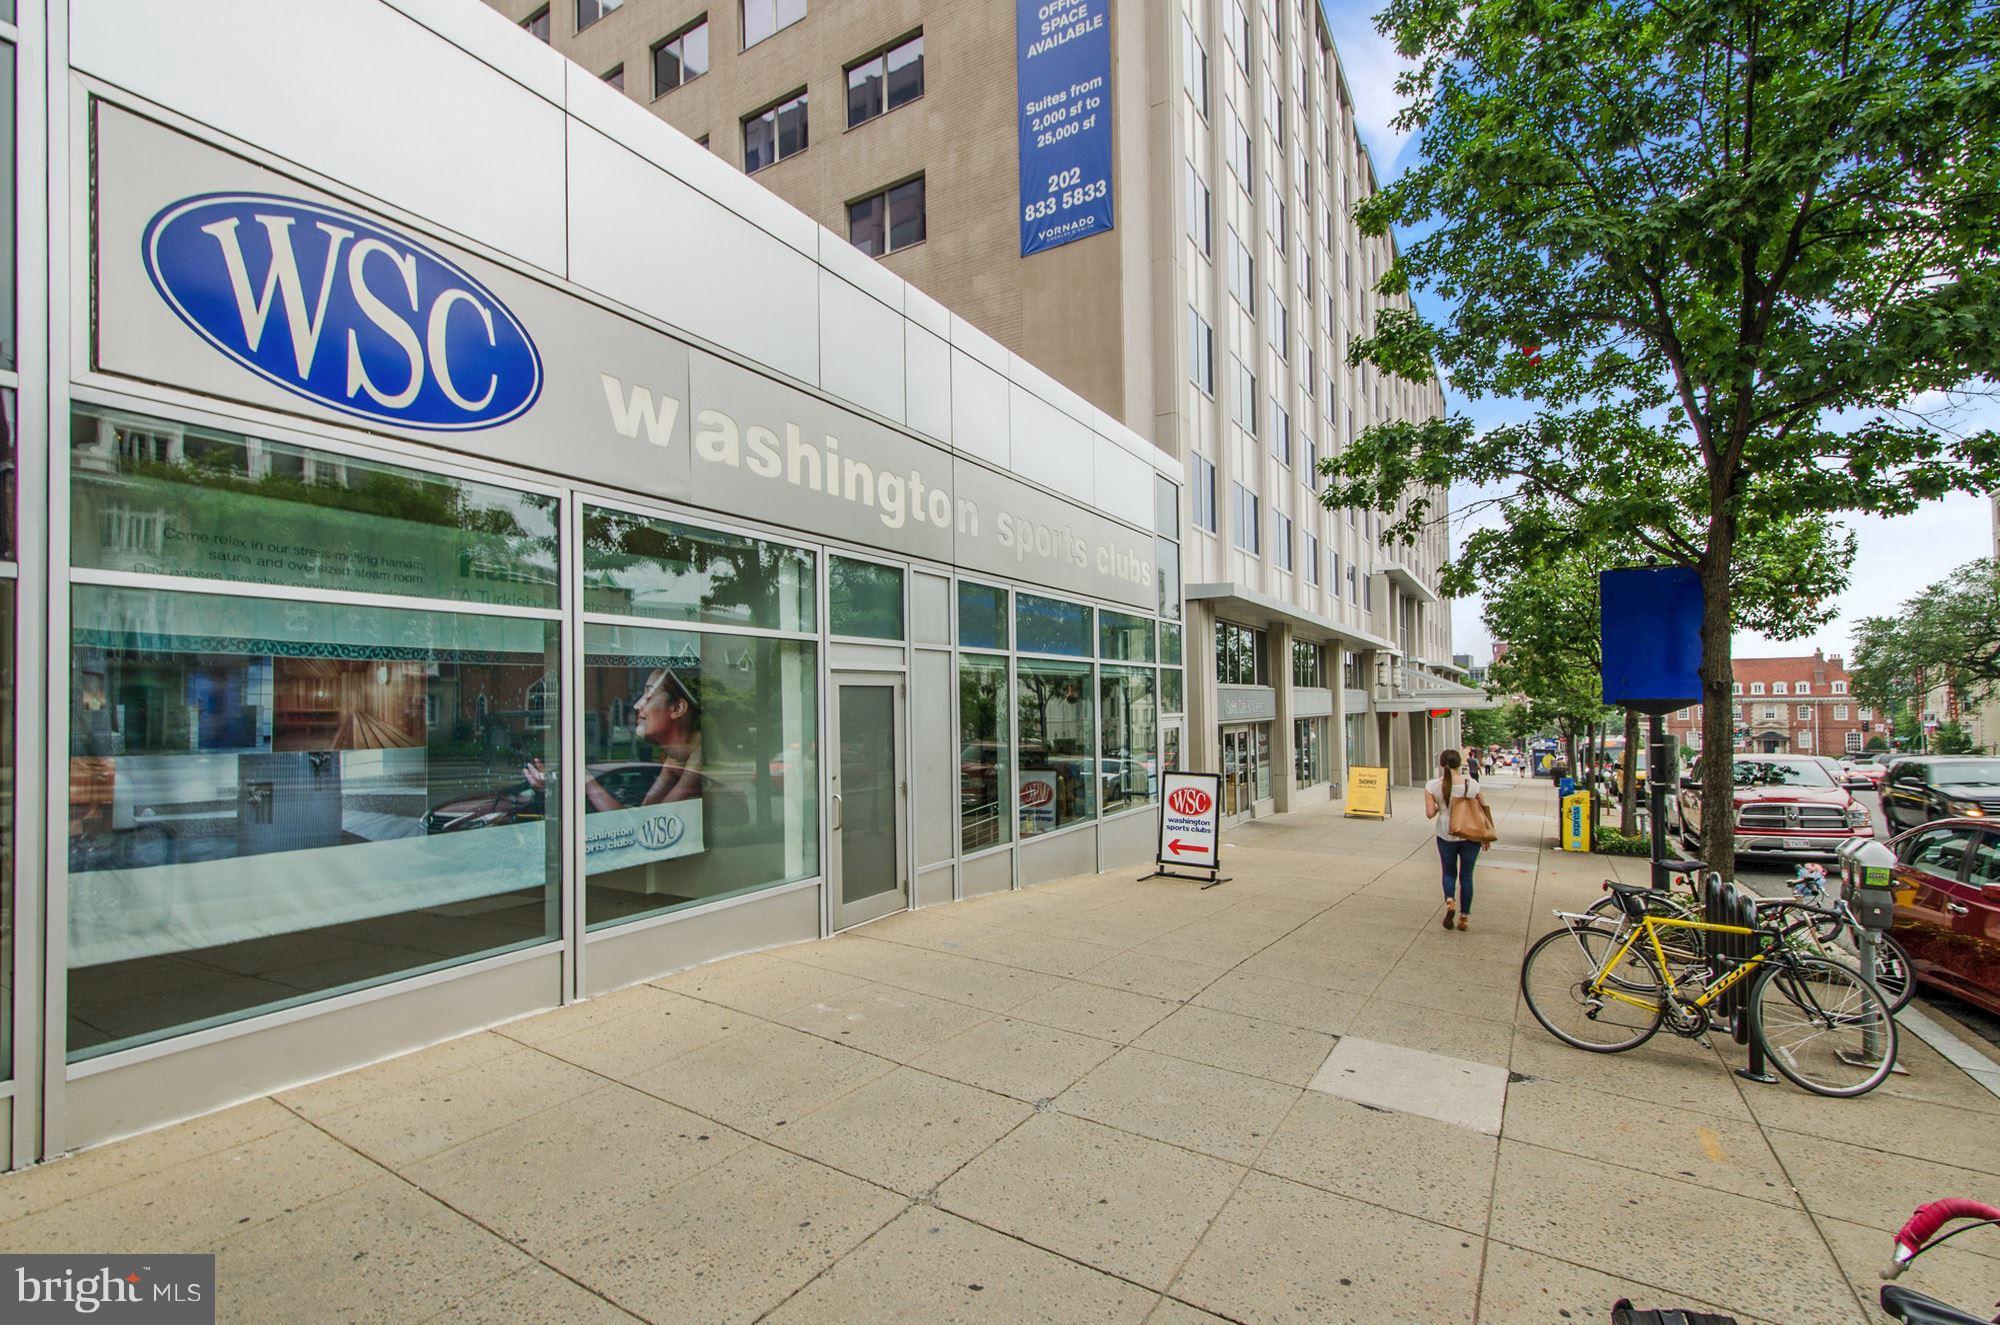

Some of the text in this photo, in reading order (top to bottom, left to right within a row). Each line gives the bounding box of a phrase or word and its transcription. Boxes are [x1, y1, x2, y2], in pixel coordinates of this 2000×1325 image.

[1038, 0, 1084, 20] OFFI
[1041, 4, 1088, 36] SPACE
[1027, 14, 1103, 59] AVAILABLE
[1026, 76, 1102, 116] Suites from
[1032, 97, 1100, 132] 2,000 sf to
[1037, 114, 1096, 148] 25,000 sf
[1048, 166, 1081, 193] 202
[1024, 179, 1107, 222] 833 5833
[1038, 215, 1095, 241] VORNADO
[201, 213, 498, 412] WSC
[600, 372, 1151, 587] washington sports clubs
[163, 526, 209, 544] Come
[214, 534, 247, 550] relax
[251, 538, 264, 551] in
[267, 542, 290, 555] our
[293, 546, 378, 568] stress-mlting
[208, 549, 252, 566] sauna
[256, 557, 283, 570] and
[354, 569, 391, 581] steam
[1173, 789, 1206, 814] WSC
[586, 827, 634, 842] shington
[642, 816, 677, 845] WSC
[1168, 817, 1211, 827] washington
[1191, 826, 1212, 834] clubs
[1572, 805, 1581, 837] express
[607, 838, 634, 849] clubs
